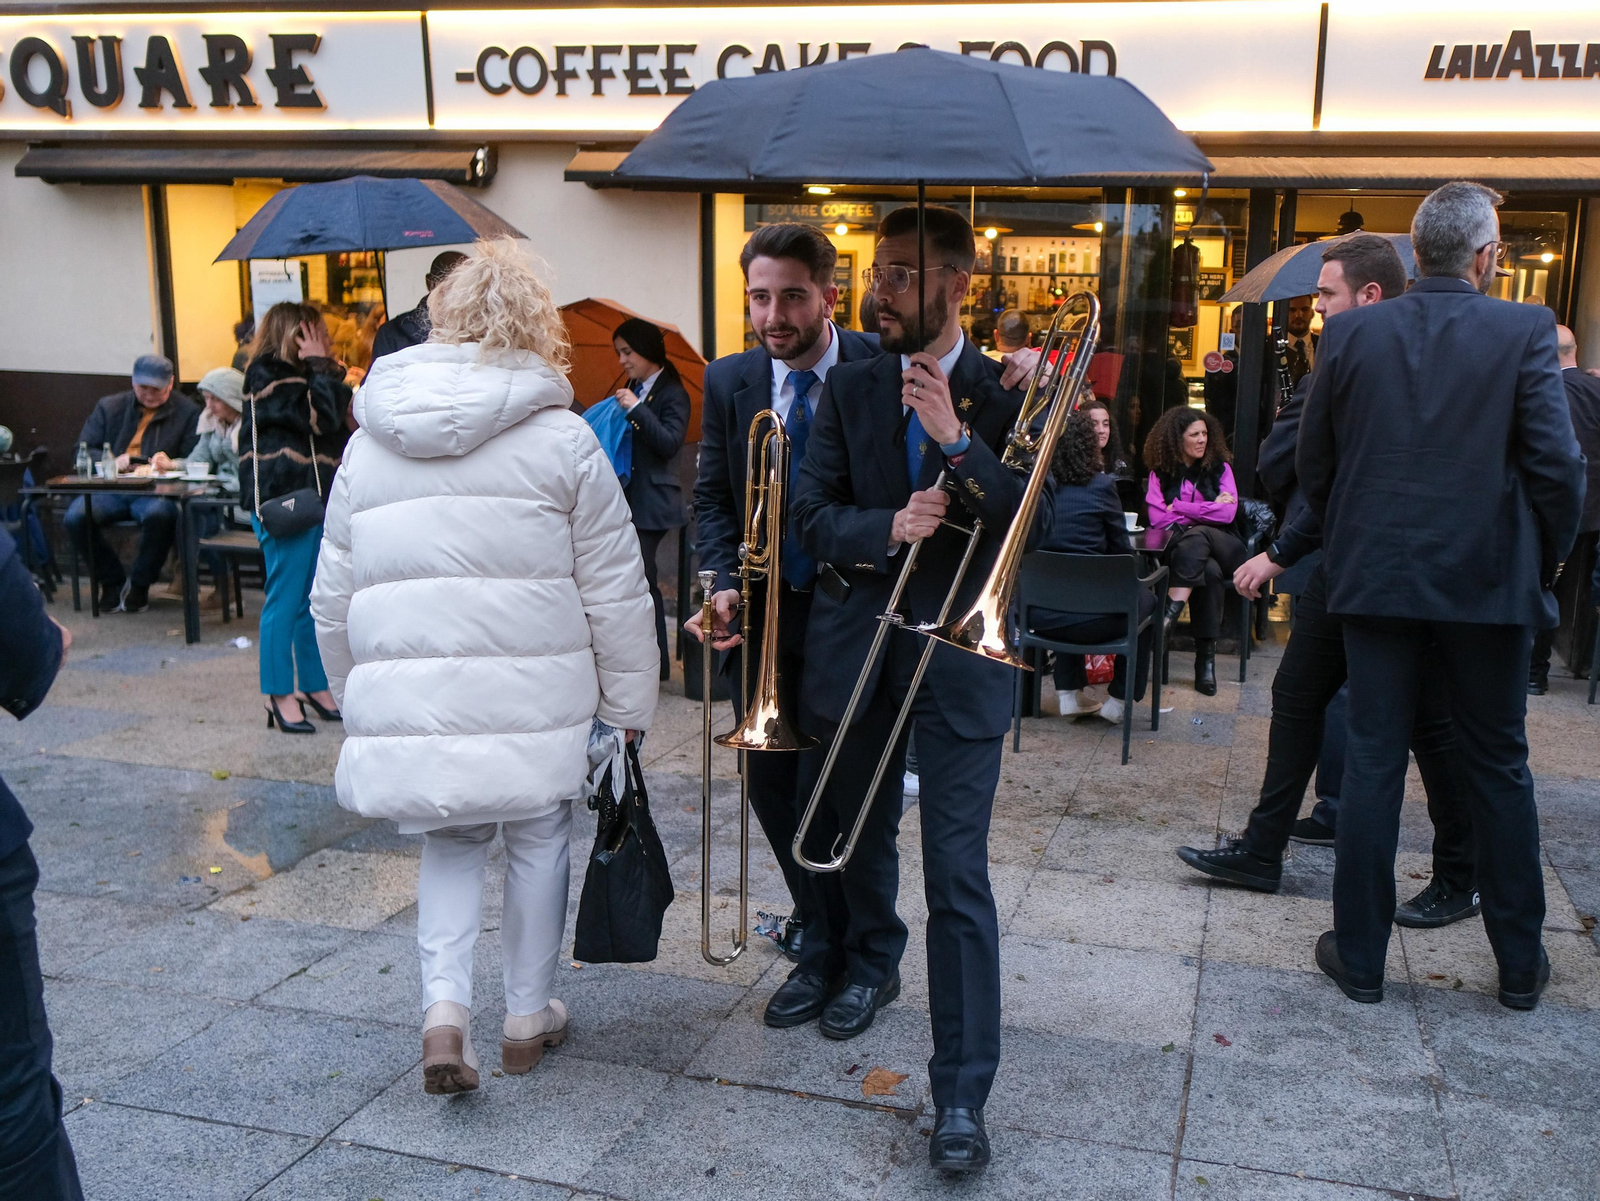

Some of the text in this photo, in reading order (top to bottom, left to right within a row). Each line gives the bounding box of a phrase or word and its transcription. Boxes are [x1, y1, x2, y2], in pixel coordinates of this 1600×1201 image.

[0, 34, 327, 120] QUARE
[958, 40, 1117, 77] OD
[821, 204, 874, 217] COFFEE
